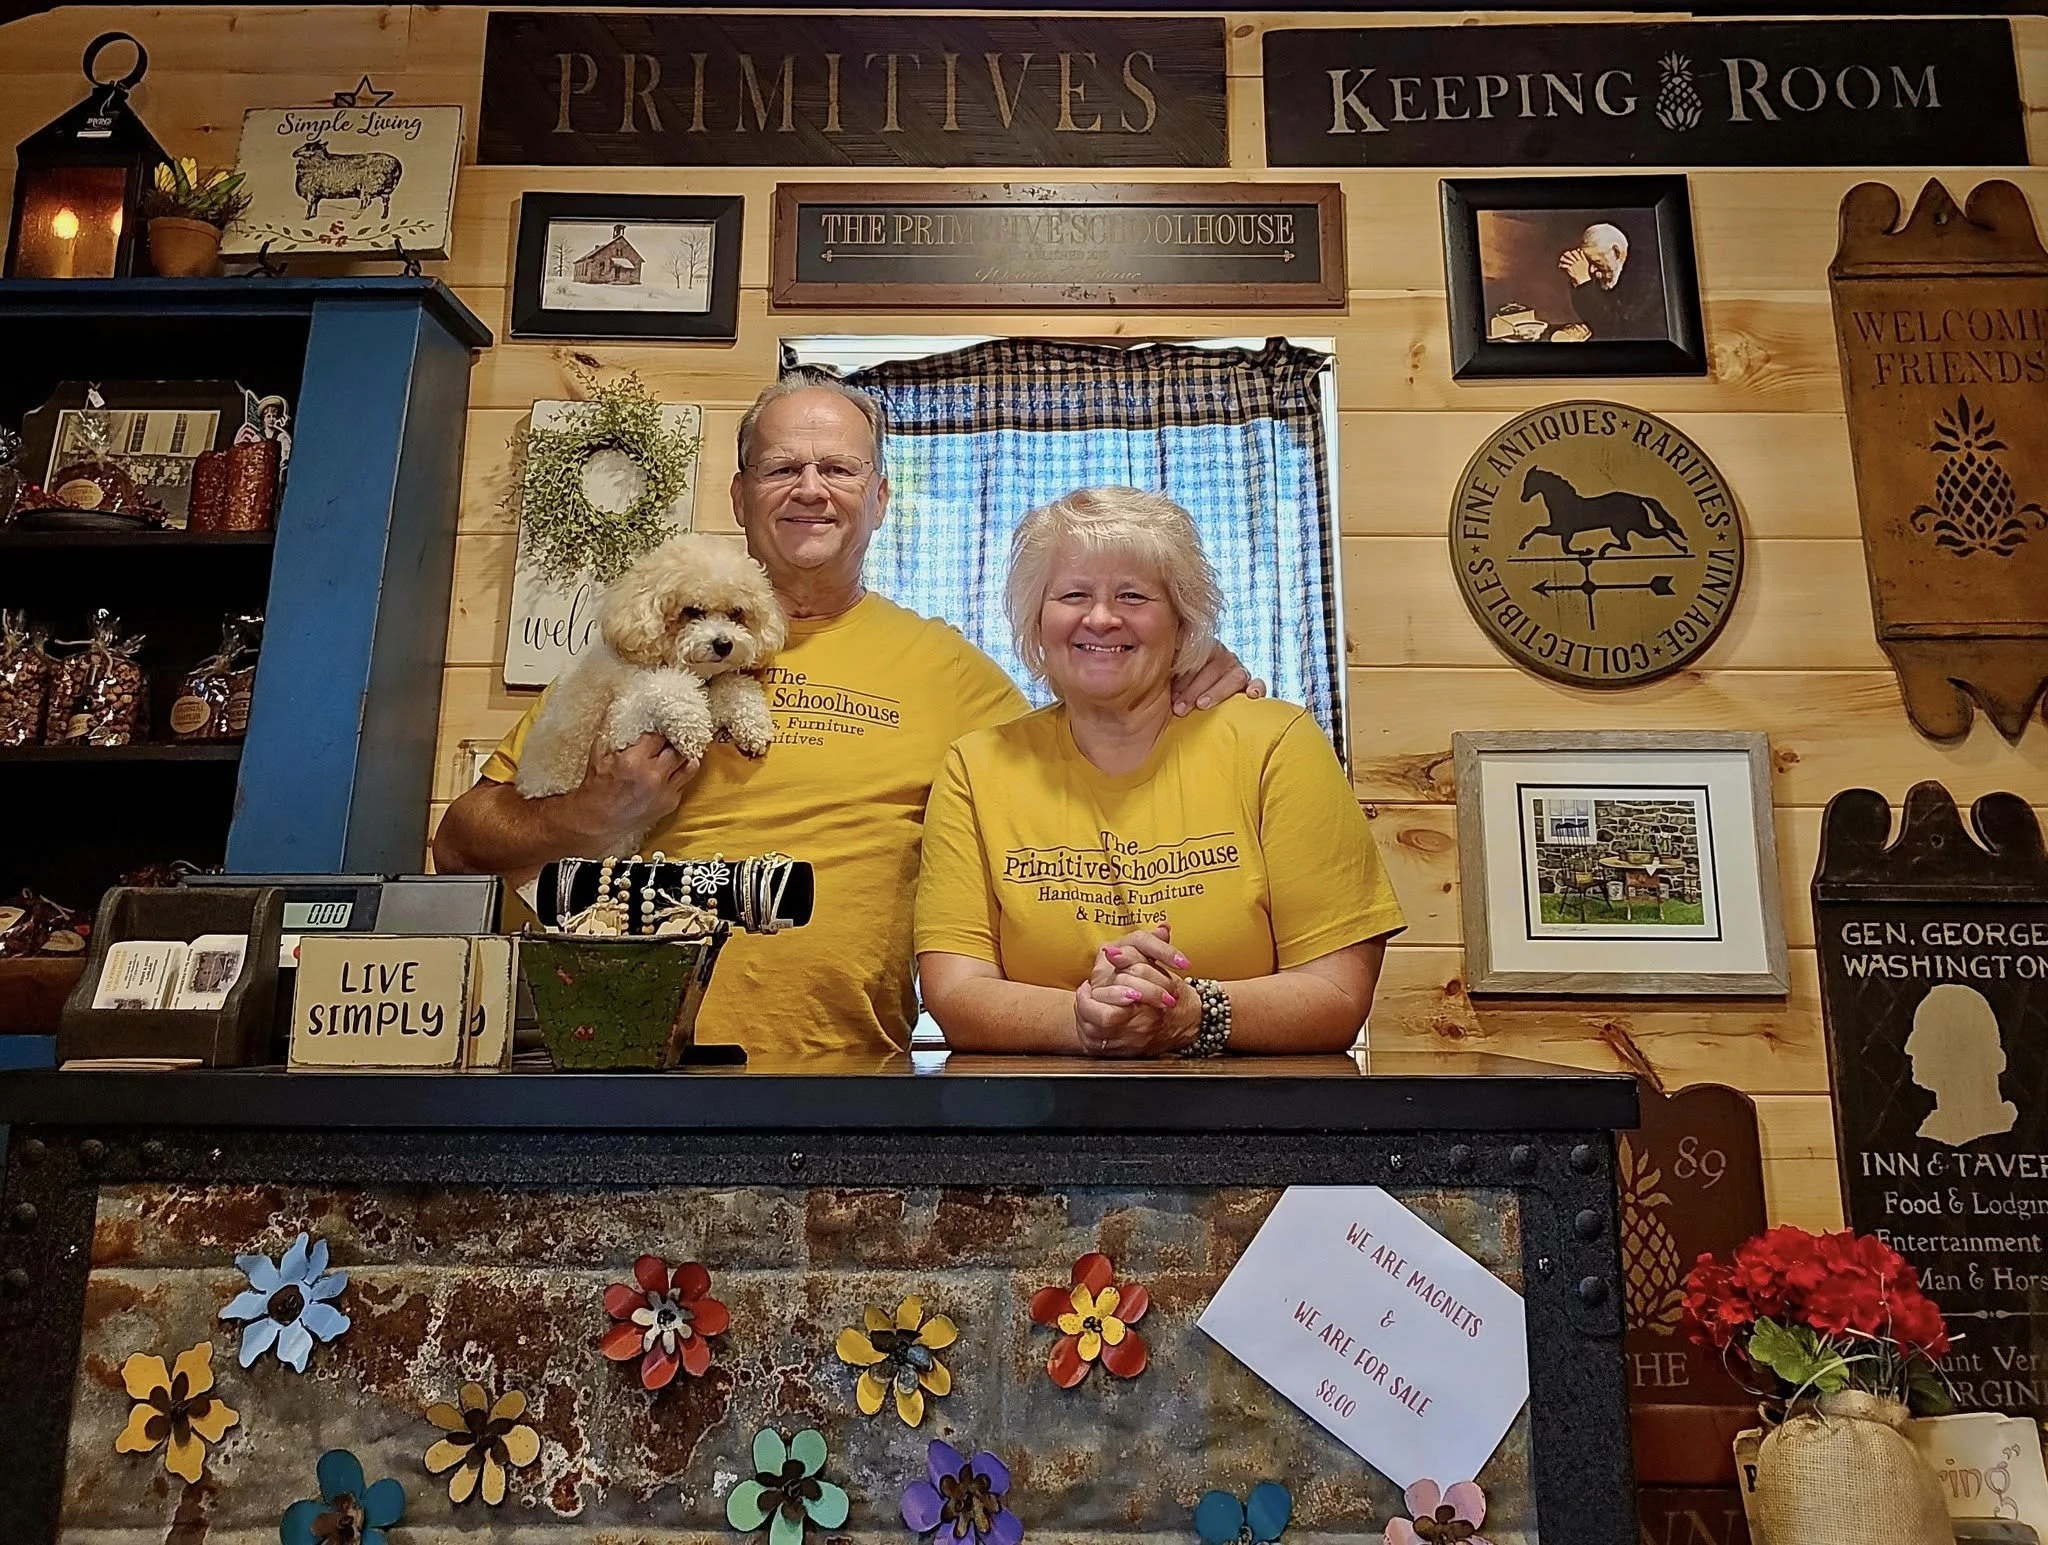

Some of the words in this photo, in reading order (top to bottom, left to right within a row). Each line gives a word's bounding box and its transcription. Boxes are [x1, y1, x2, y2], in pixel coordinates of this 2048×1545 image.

[552, 52, 1157, 133] PRIMITIVES
[1325, 68, 1639, 134] KEEPING
[1719, 57, 1943, 122] ROOM
[277, 109, 354, 142] Simple
[357, 111, 422, 141] Living
[821, 213, 887, 245] THE
[891, 213, 1064, 246] PRIMIVE
[1874, 350, 2047, 386] FRIENDS
[1485, 409, 1618, 479] ANTIQUES
[1631, 419, 1732, 529] RARITIES
[1463, 475, 1500, 541] FINE
[1468, 556, 1651, 674] COLLECTIBLES
[1656, 548, 1736, 658] VINTAGE
[766, 667, 807, 685] The
[772, 686, 900, 724] Schoolhouse
[717, 731, 731, 744] &
[787, 716, 865, 737] Furniture
[1100, 831, 1139, 856] The
[1127, 882, 1205, 906] Furniture
[307, 903, 348, 926] 0.00
[1075, 905, 1089, 921] &
[1841, 922, 1916, 946] GEN.
[1921, 922, 2048, 947] GEORGE
[341, 961, 420, 994] LIVE
[308, 1001, 445, 1037] SIMPLY
[1859, 1152, 1921, 1177] INN
[1926, 1151, 1949, 1177] &
[1884, 1191, 1943, 1215] Food
[1948, 1187, 1965, 1215] &
[1874, 1228, 2043, 1254] Entertainment
[1346, 1222, 1374, 1253] WE
[1370, 1244, 1408, 1280] ARE
[1406, 1270, 1483, 1338] MAGNETS
[1968, 1262, 1985, 1291] &
[1379, 1309, 1396, 1328] &
[1293, 1300, 1322, 1331] WE
[1317, 1323, 1356, 1358] ARE
[1353, 1348, 1389, 1386] FOR
[1389, 1376, 1433, 1418] SALE
[1626, 1352, 1689, 1387] HE
[1928, 1351, 1984, 1374] unt
[1315, 1377, 1357, 1418] $8.00
